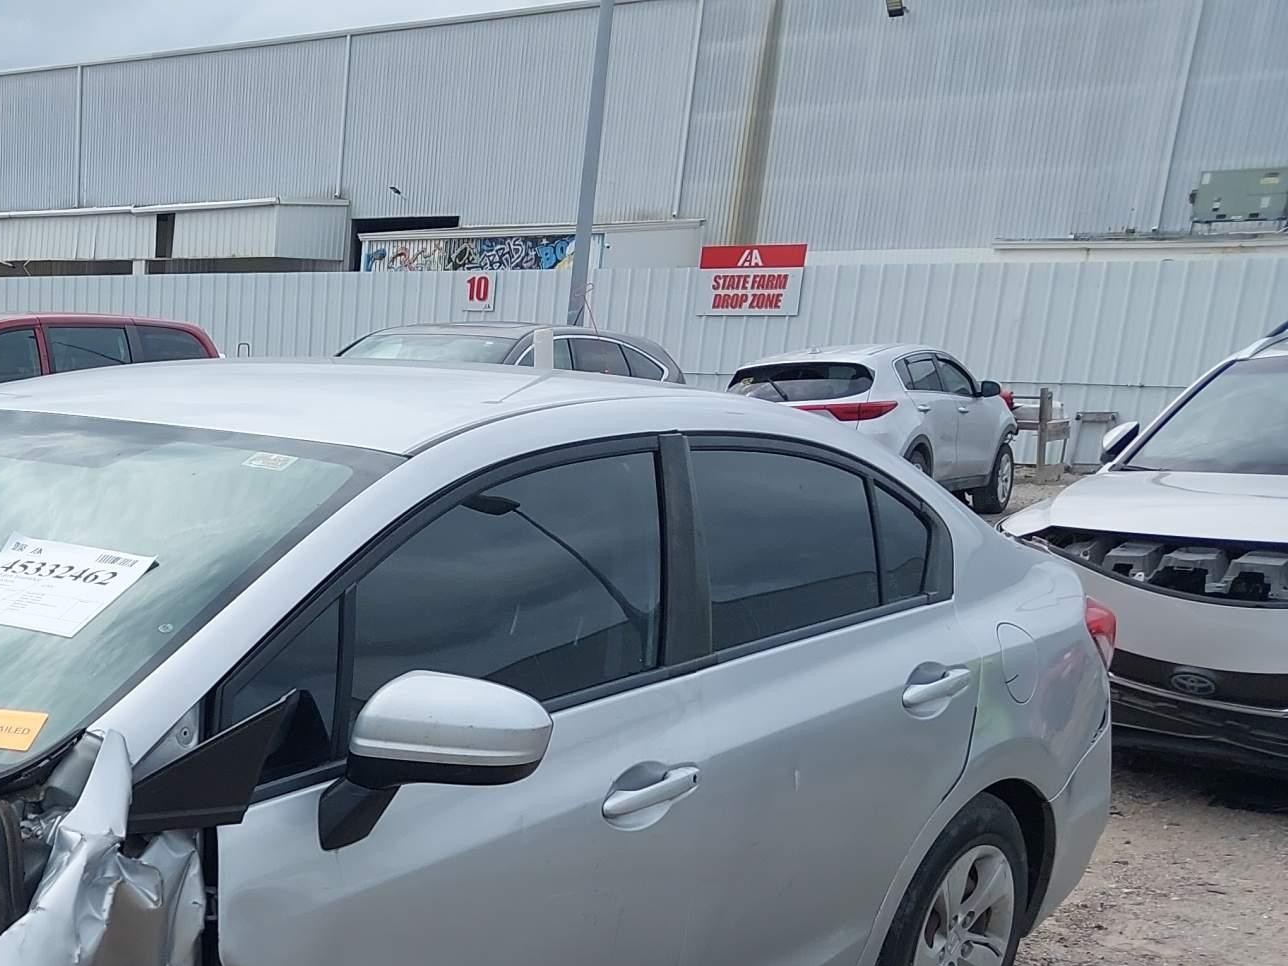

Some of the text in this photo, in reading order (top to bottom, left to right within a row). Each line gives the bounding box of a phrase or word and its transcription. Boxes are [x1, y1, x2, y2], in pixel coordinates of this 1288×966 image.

[467, 276, 489, 302] 10
[712, 273, 789, 291] STATE FARM
[712, 293, 783, 310] DROP ZONE
[0, 559, 118, 586] 45332462
